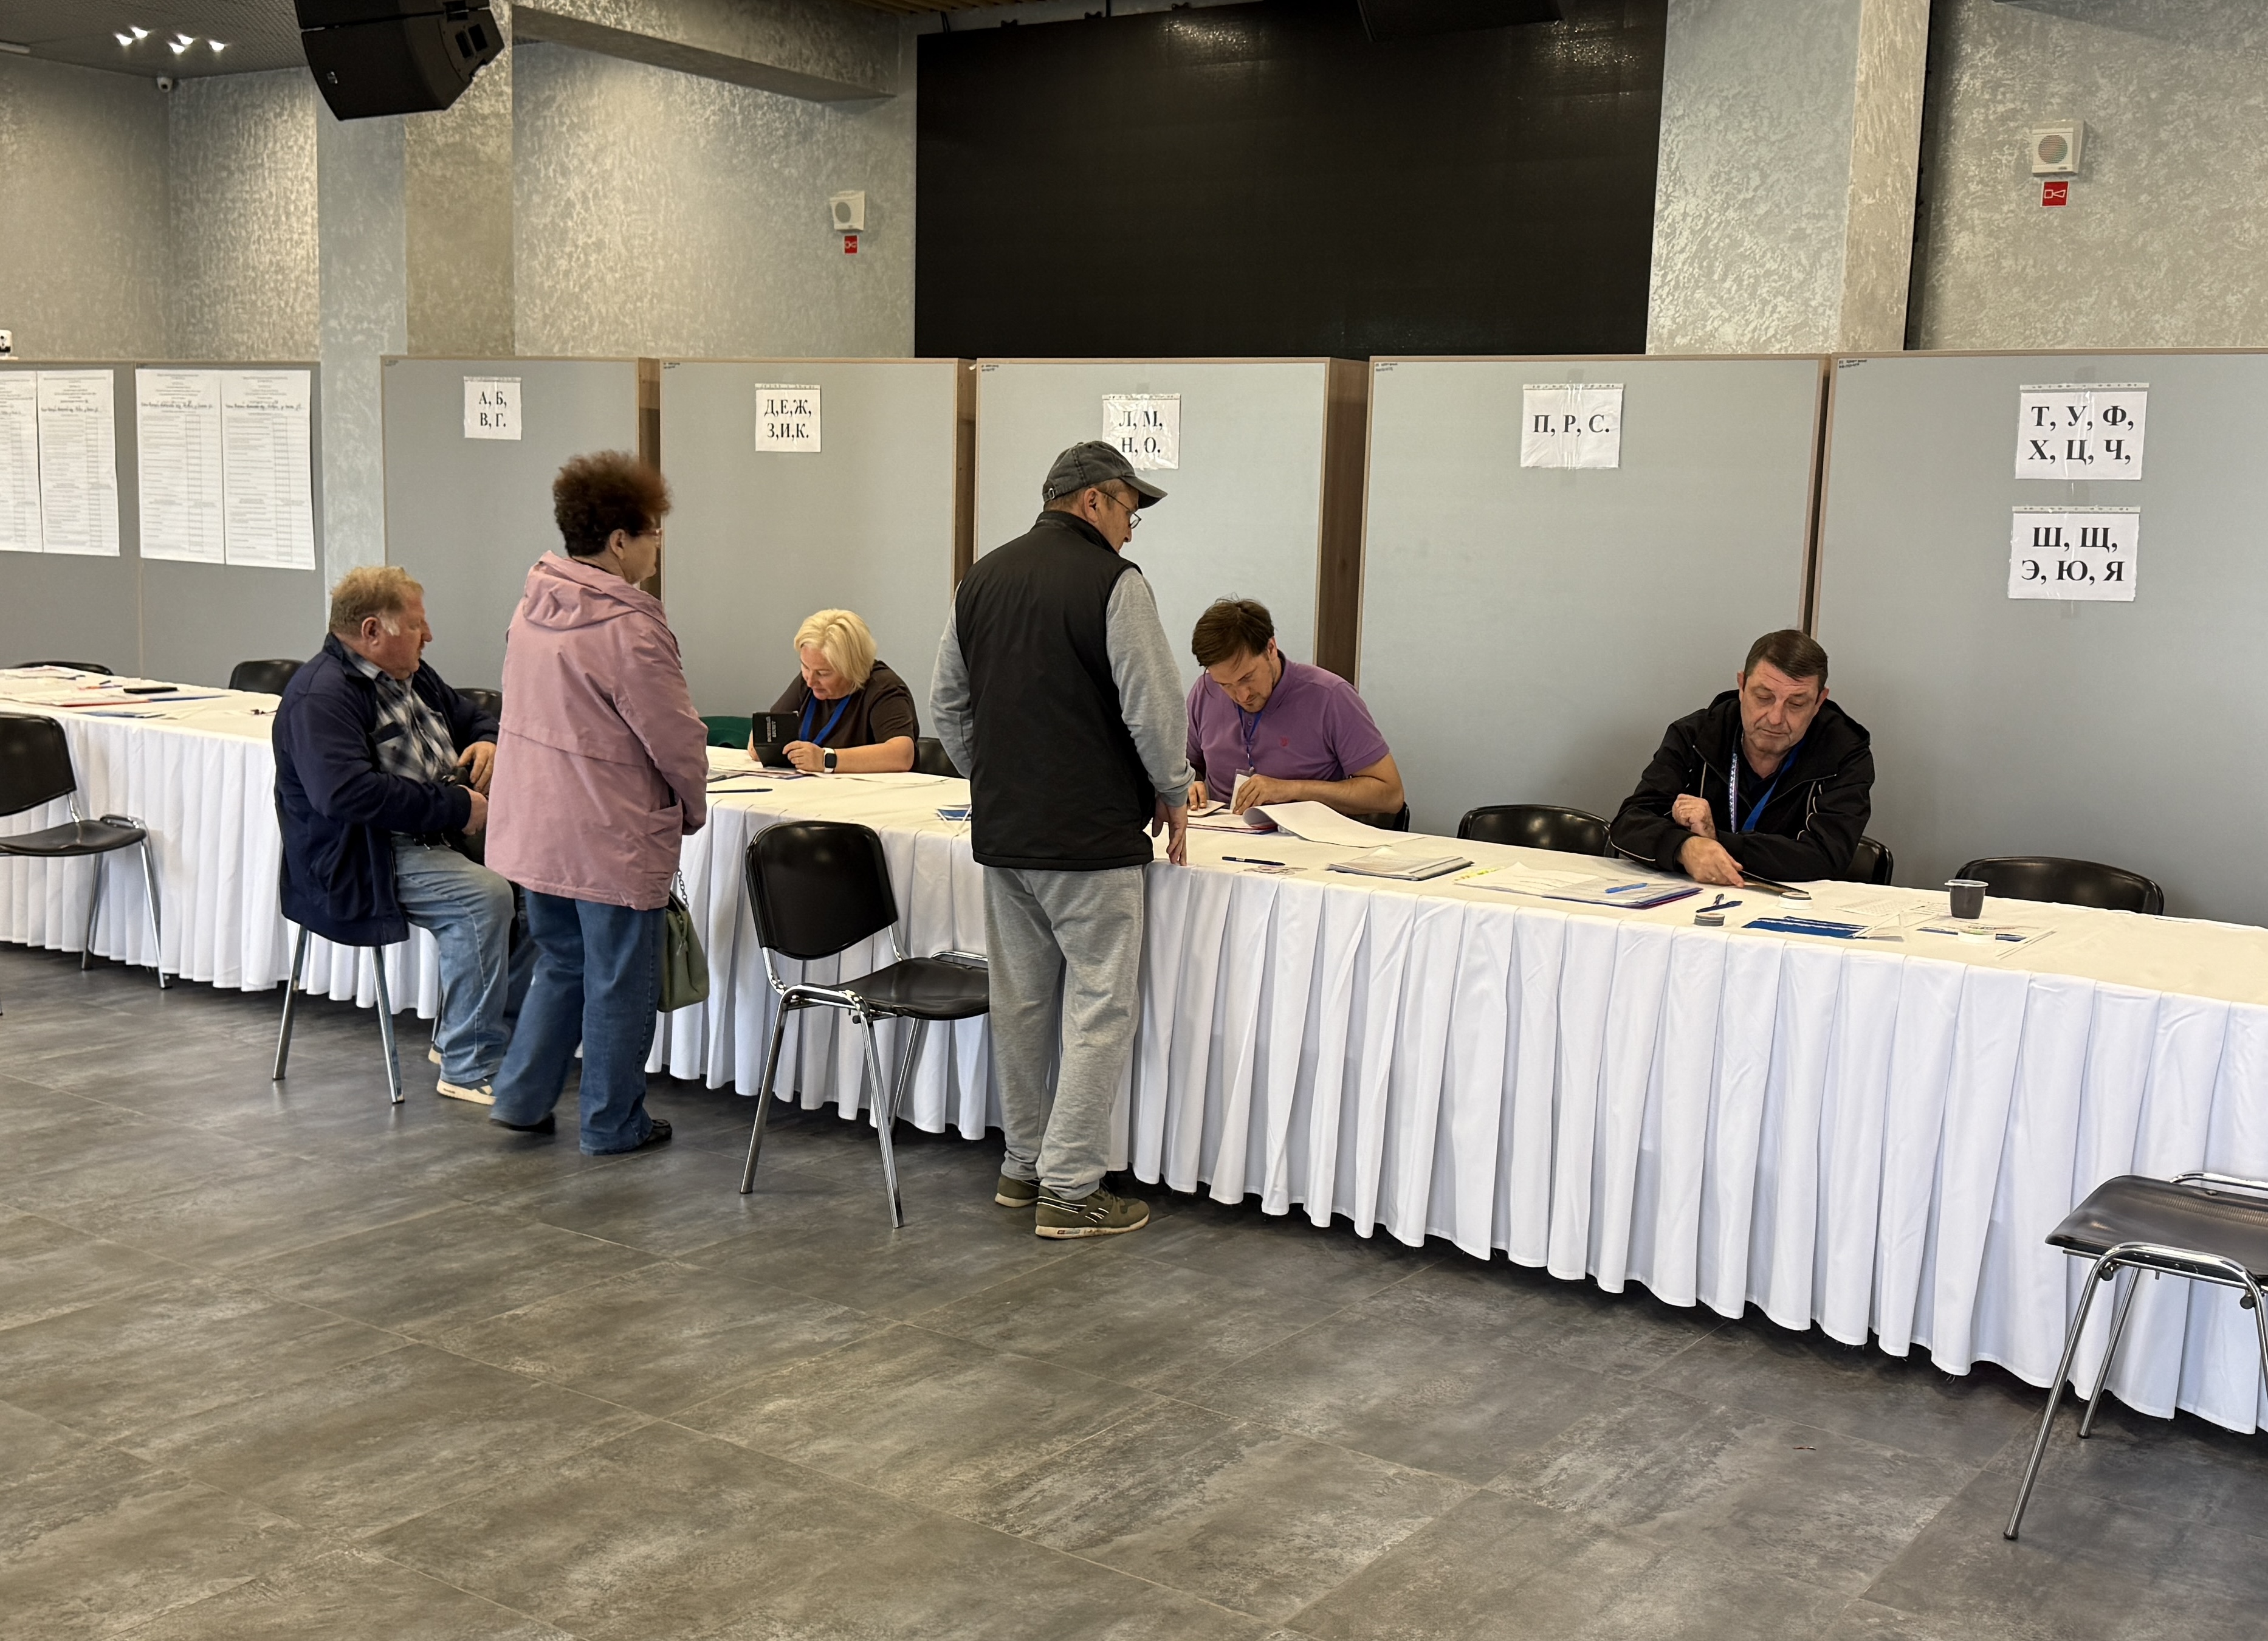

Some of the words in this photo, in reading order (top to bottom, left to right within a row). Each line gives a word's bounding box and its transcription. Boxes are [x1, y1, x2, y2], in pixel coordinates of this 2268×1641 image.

[479, 391, 491, 407] А,
[496, 391, 507, 408] Б,
[480, 412, 491, 429] В,
[496, 413, 506, 427] Г.
[1119, 410, 1137, 430] Л,
[1533, 415, 1556, 436] П,
[1562, 415, 1581, 437] Р,
[1589, 414, 1609, 433] С.
[2031, 405, 2056, 431] Т,
[2066, 405, 2093, 431] У,
[2102, 405, 2134, 431] Ф,
[1121, 437, 1138, 456] Н,
[1144, 436, 1161, 453] О.
[2028, 439, 2056, 464] Х,
[2066, 439, 2094, 466] Ц,
[2103, 439, 2131, 464] Ч,
[2032, 526, 2070, 552] Ш,
[2080, 526, 2118, 553] Щ,
[2021, 560, 2047, 585] Э,
[2055, 560, 2095, 585] Ю,
[2103, 560, 2126, 582] Я
